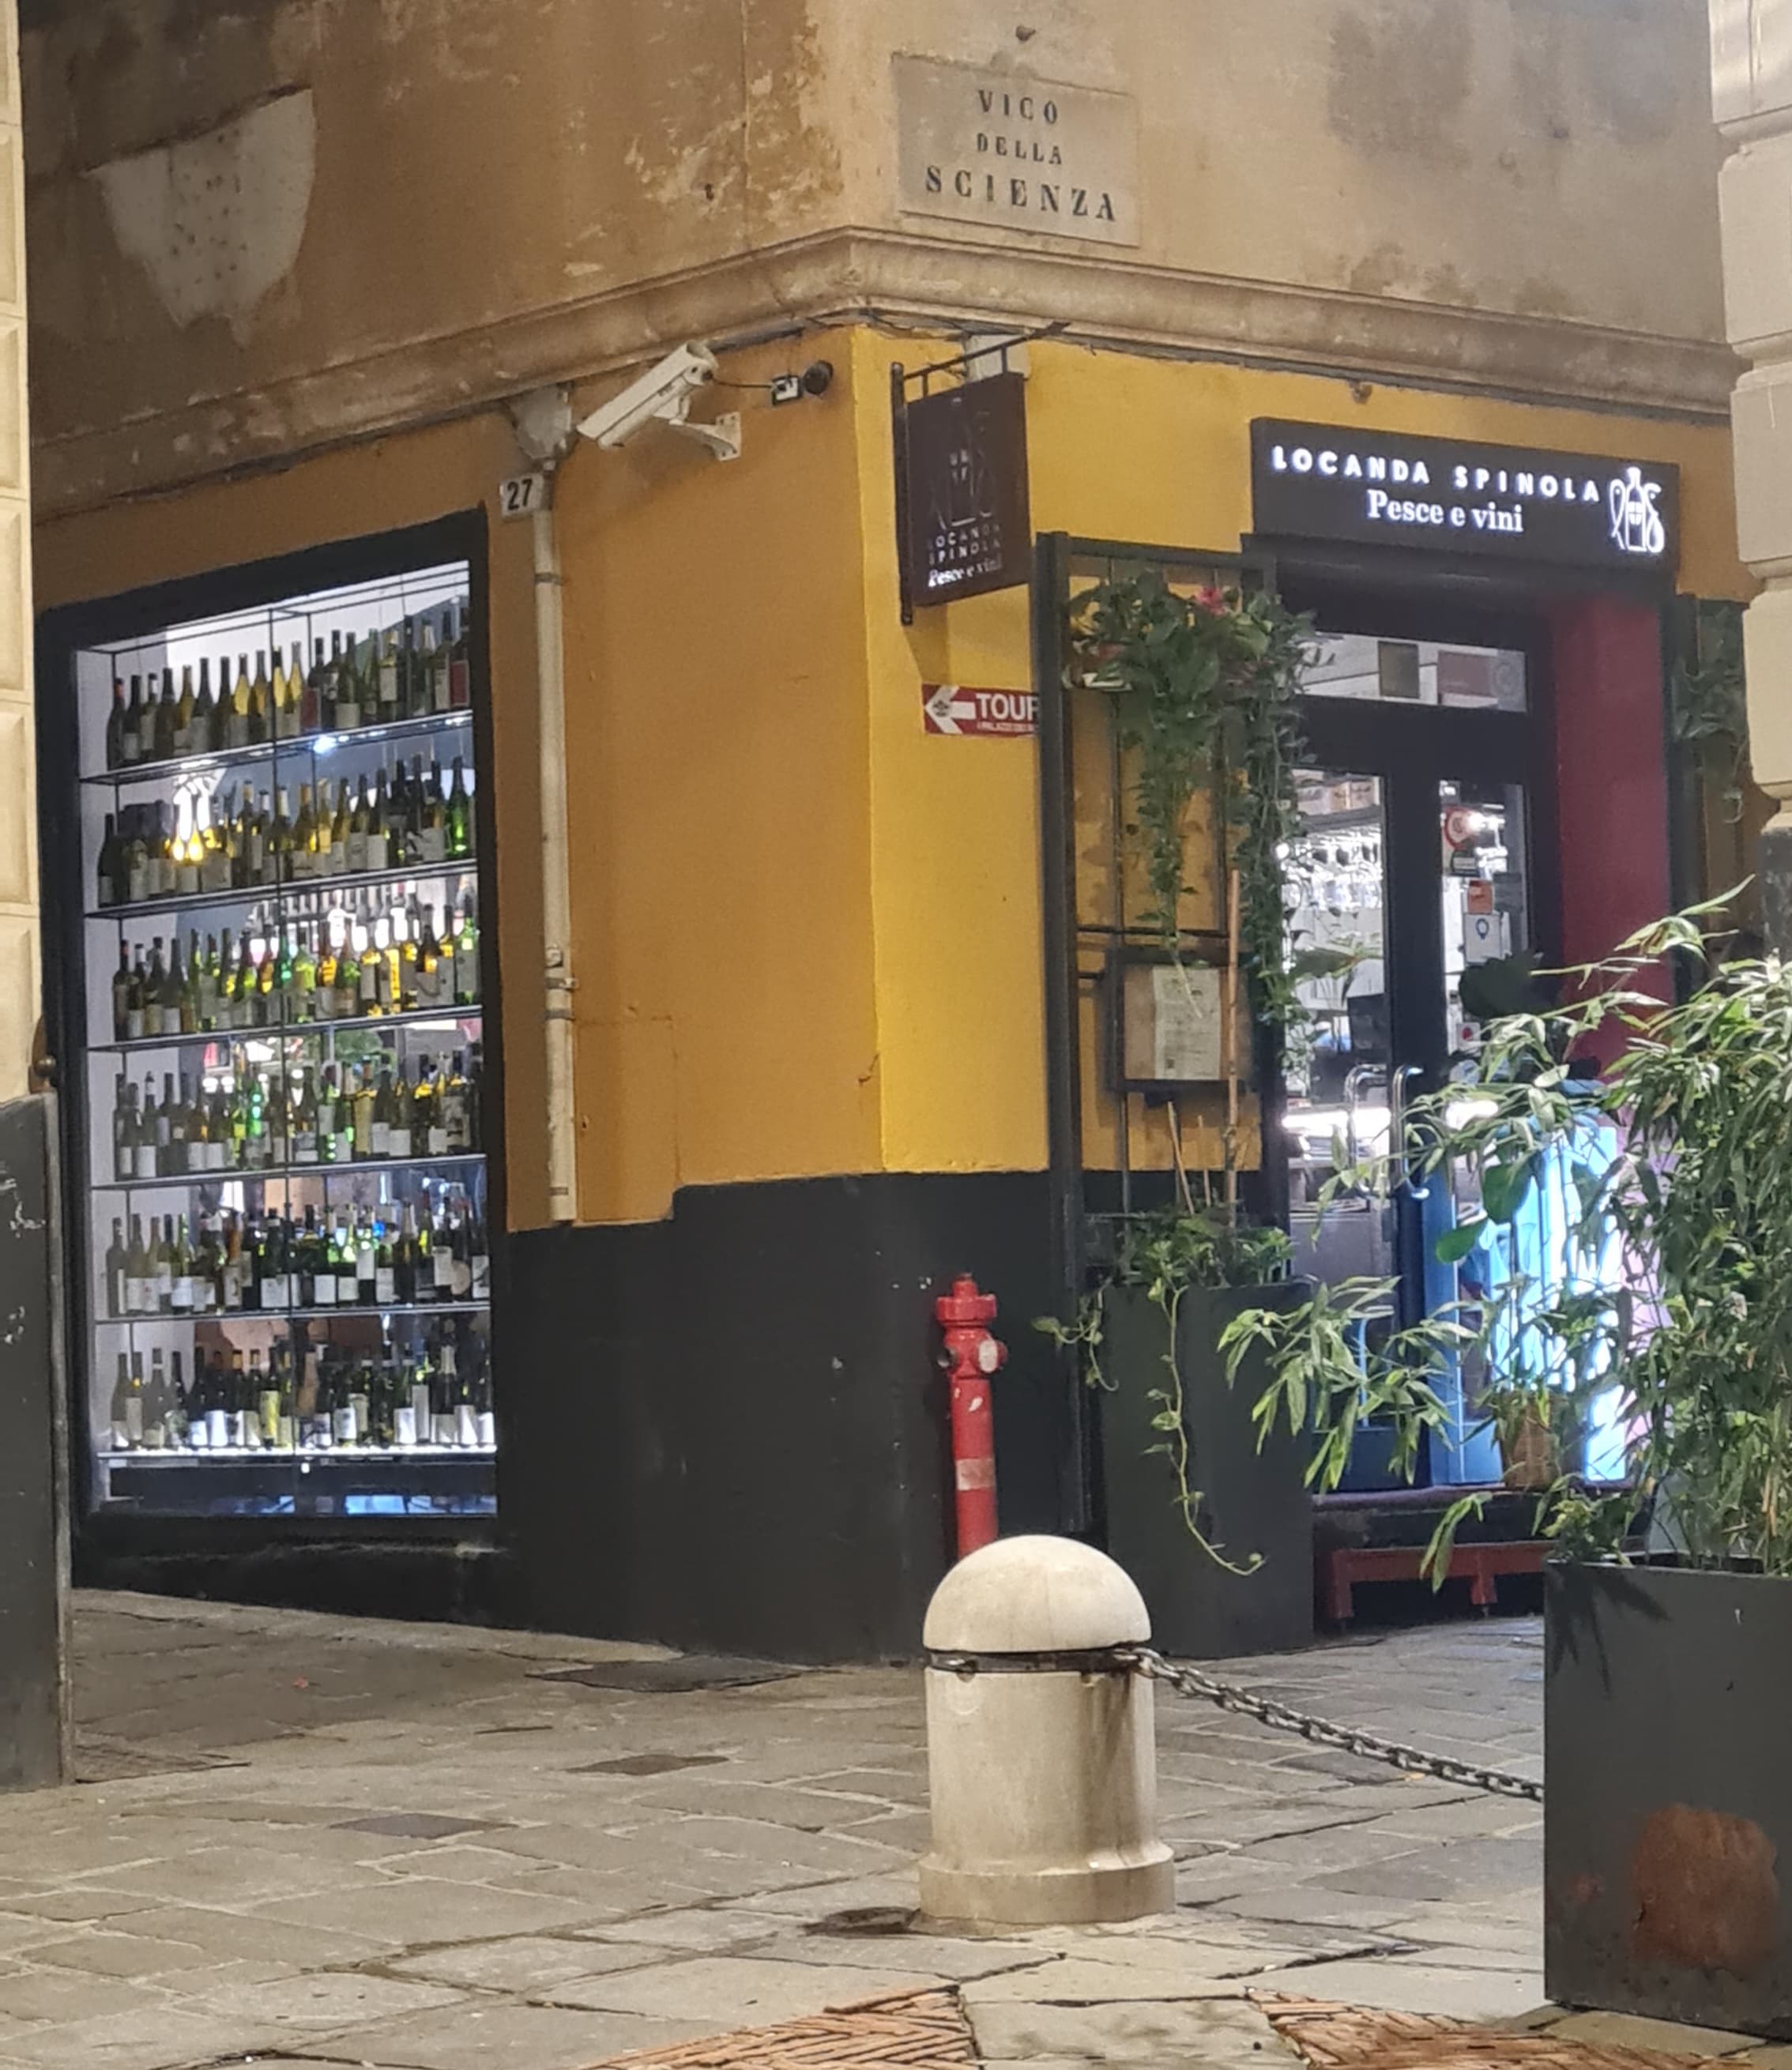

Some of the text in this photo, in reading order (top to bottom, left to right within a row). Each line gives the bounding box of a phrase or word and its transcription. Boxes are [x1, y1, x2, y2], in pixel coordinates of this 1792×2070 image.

[977, 88, 1059, 125] VICO
[977, 132, 1063, 165] DELLA
[925, 164, 1116, 222] SCIENZA
[506, 477, 533, 510] 27
[1271, 445, 1601, 502] LOCANDA SPINOLA
[1365, 488, 1524, 533] Pesce e vini
